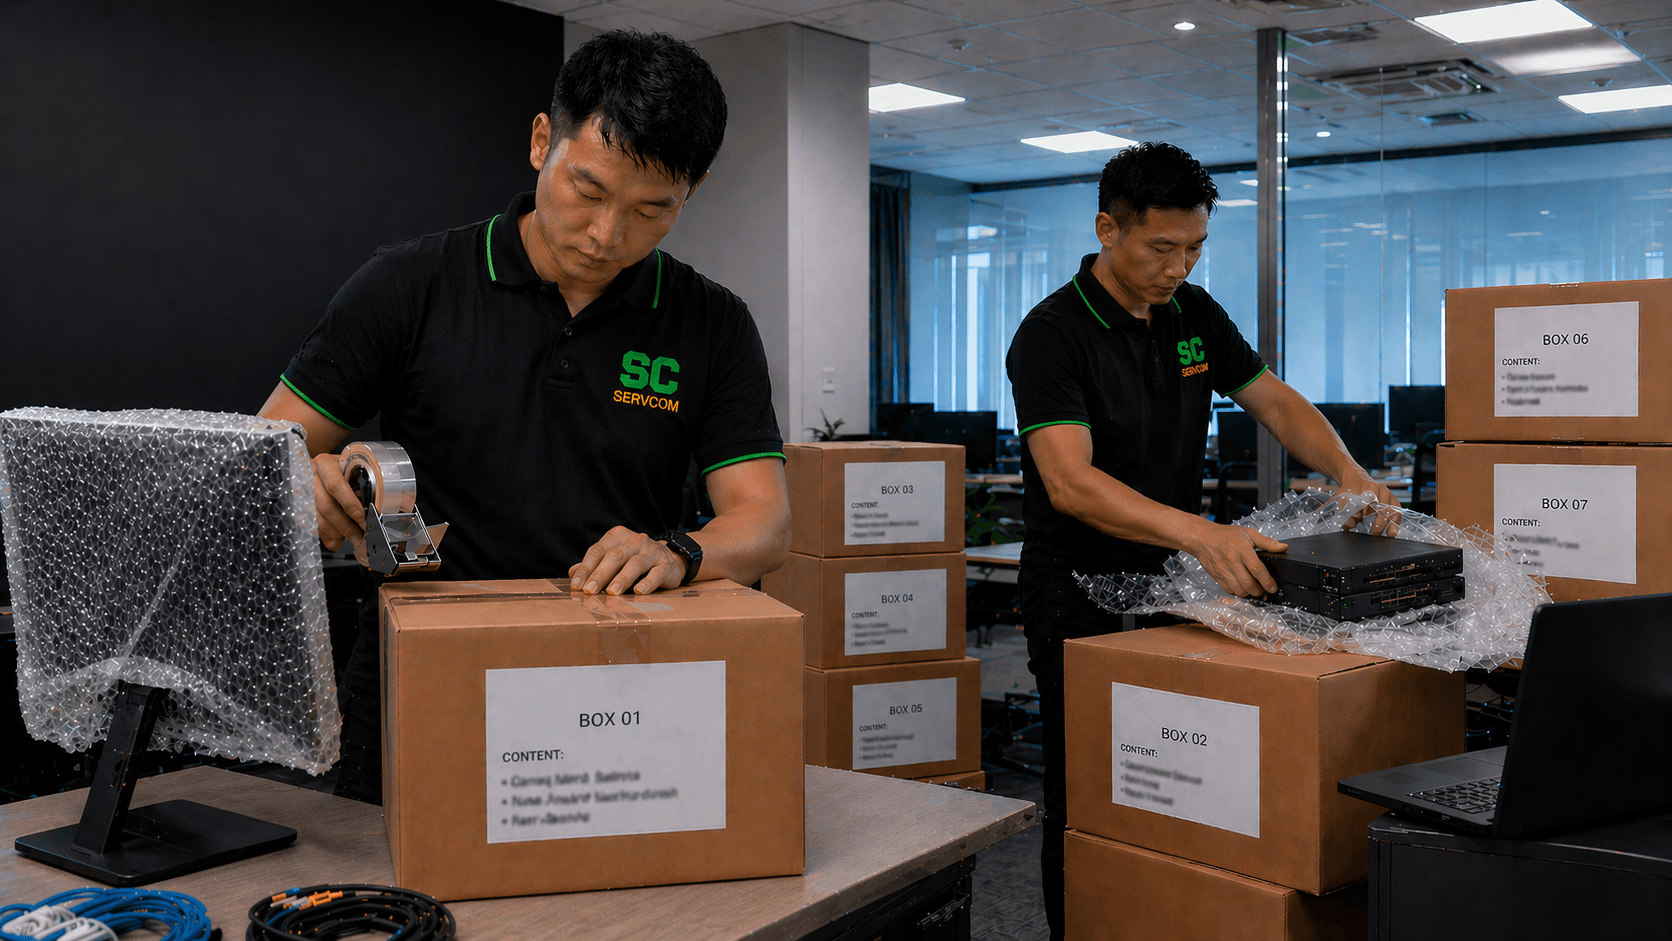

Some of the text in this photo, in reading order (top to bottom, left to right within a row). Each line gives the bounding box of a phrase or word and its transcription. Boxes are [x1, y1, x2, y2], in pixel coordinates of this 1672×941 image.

[1542, 333, 1589, 346] BOX 06
[1177, 336, 1205, 366] SC
[1502, 358, 1541, 366] CONTENT:
[620, 350, 680, 395] SC
[613, 390, 679, 413] SERVCOM
[881, 485, 914, 495] BOX 03
[851, 501, 879, 509] CONTENT:
[1541, 498, 1588, 510] BOX 07
[1501, 518, 1541, 527] CONTENT:
[881, 593, 914, 604] BOX 04
[851, 611, 879, 619] CONTENT:
[889, 704, 923, 715] BOX 05
[579, 711, 641, 728] BOX 01
[858, 723, 888, 732] CONTENT:
[1161, 727, 1208, 747] BOX 02
[502, 749, 564, 763] CONTENT:
[1120, 743, 1158, 758] CONTENT:
